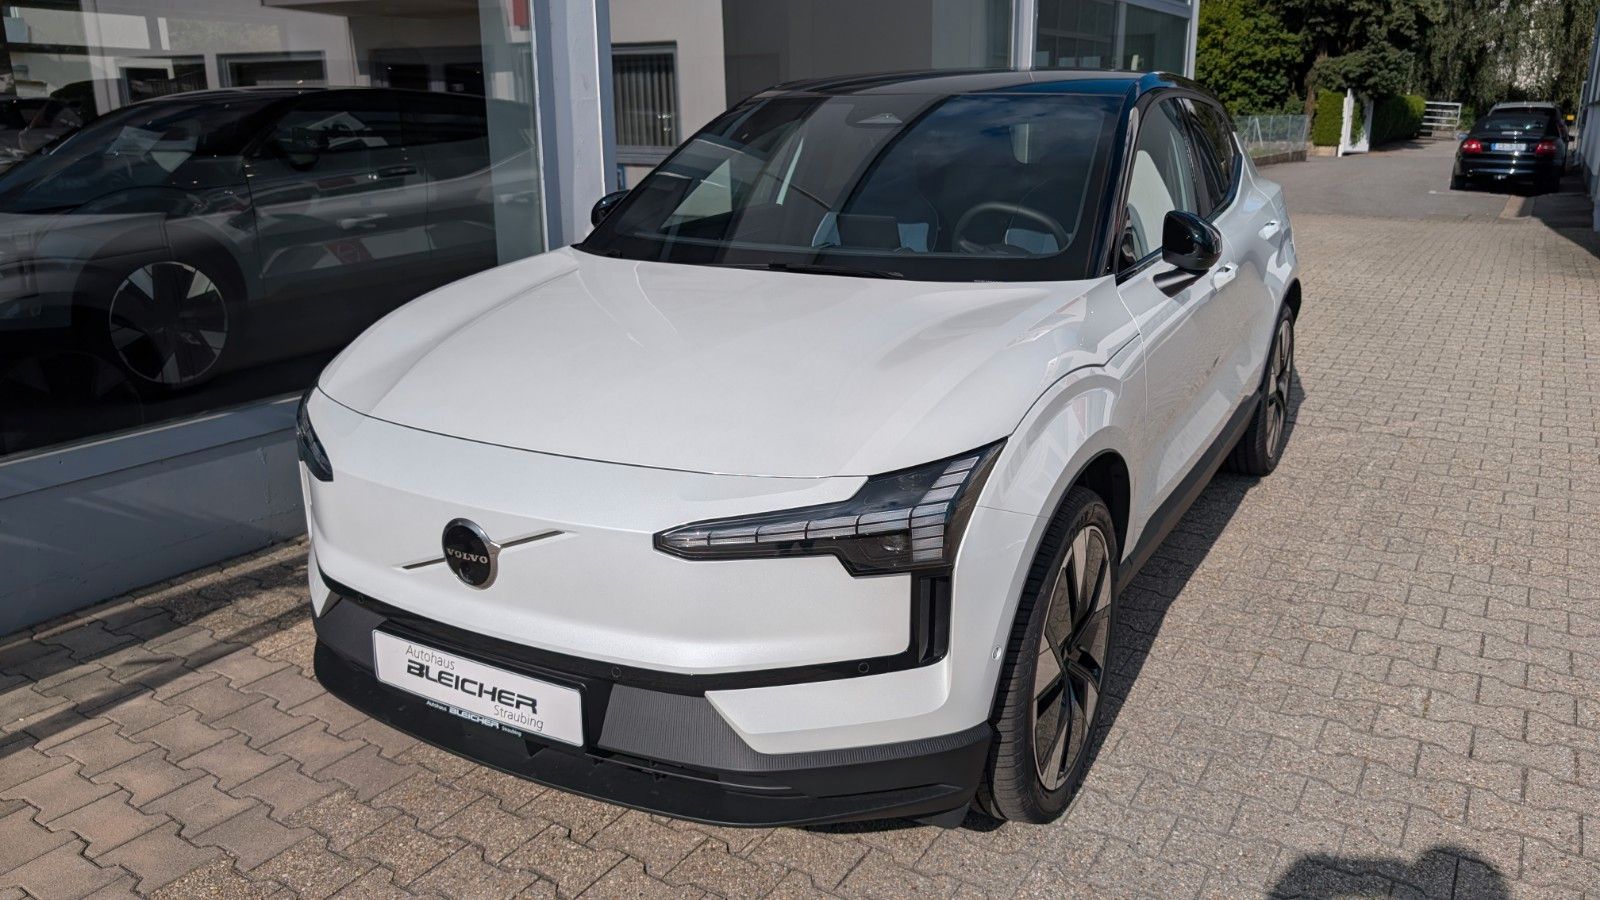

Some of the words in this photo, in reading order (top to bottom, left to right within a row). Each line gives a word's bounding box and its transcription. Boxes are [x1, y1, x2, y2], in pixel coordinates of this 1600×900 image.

[447, 548, 488, 564] VOLVO
[405, 644, 455, 671] Autohaus
[406, 659, 538, 714] BLEICHER
[426, 700, 447, 712] Autohaus
[449, 706, 500, 729] BLEICHER
[501, 726, 522, 737] Straubing
[493, 704, 544, 731] Straubing
